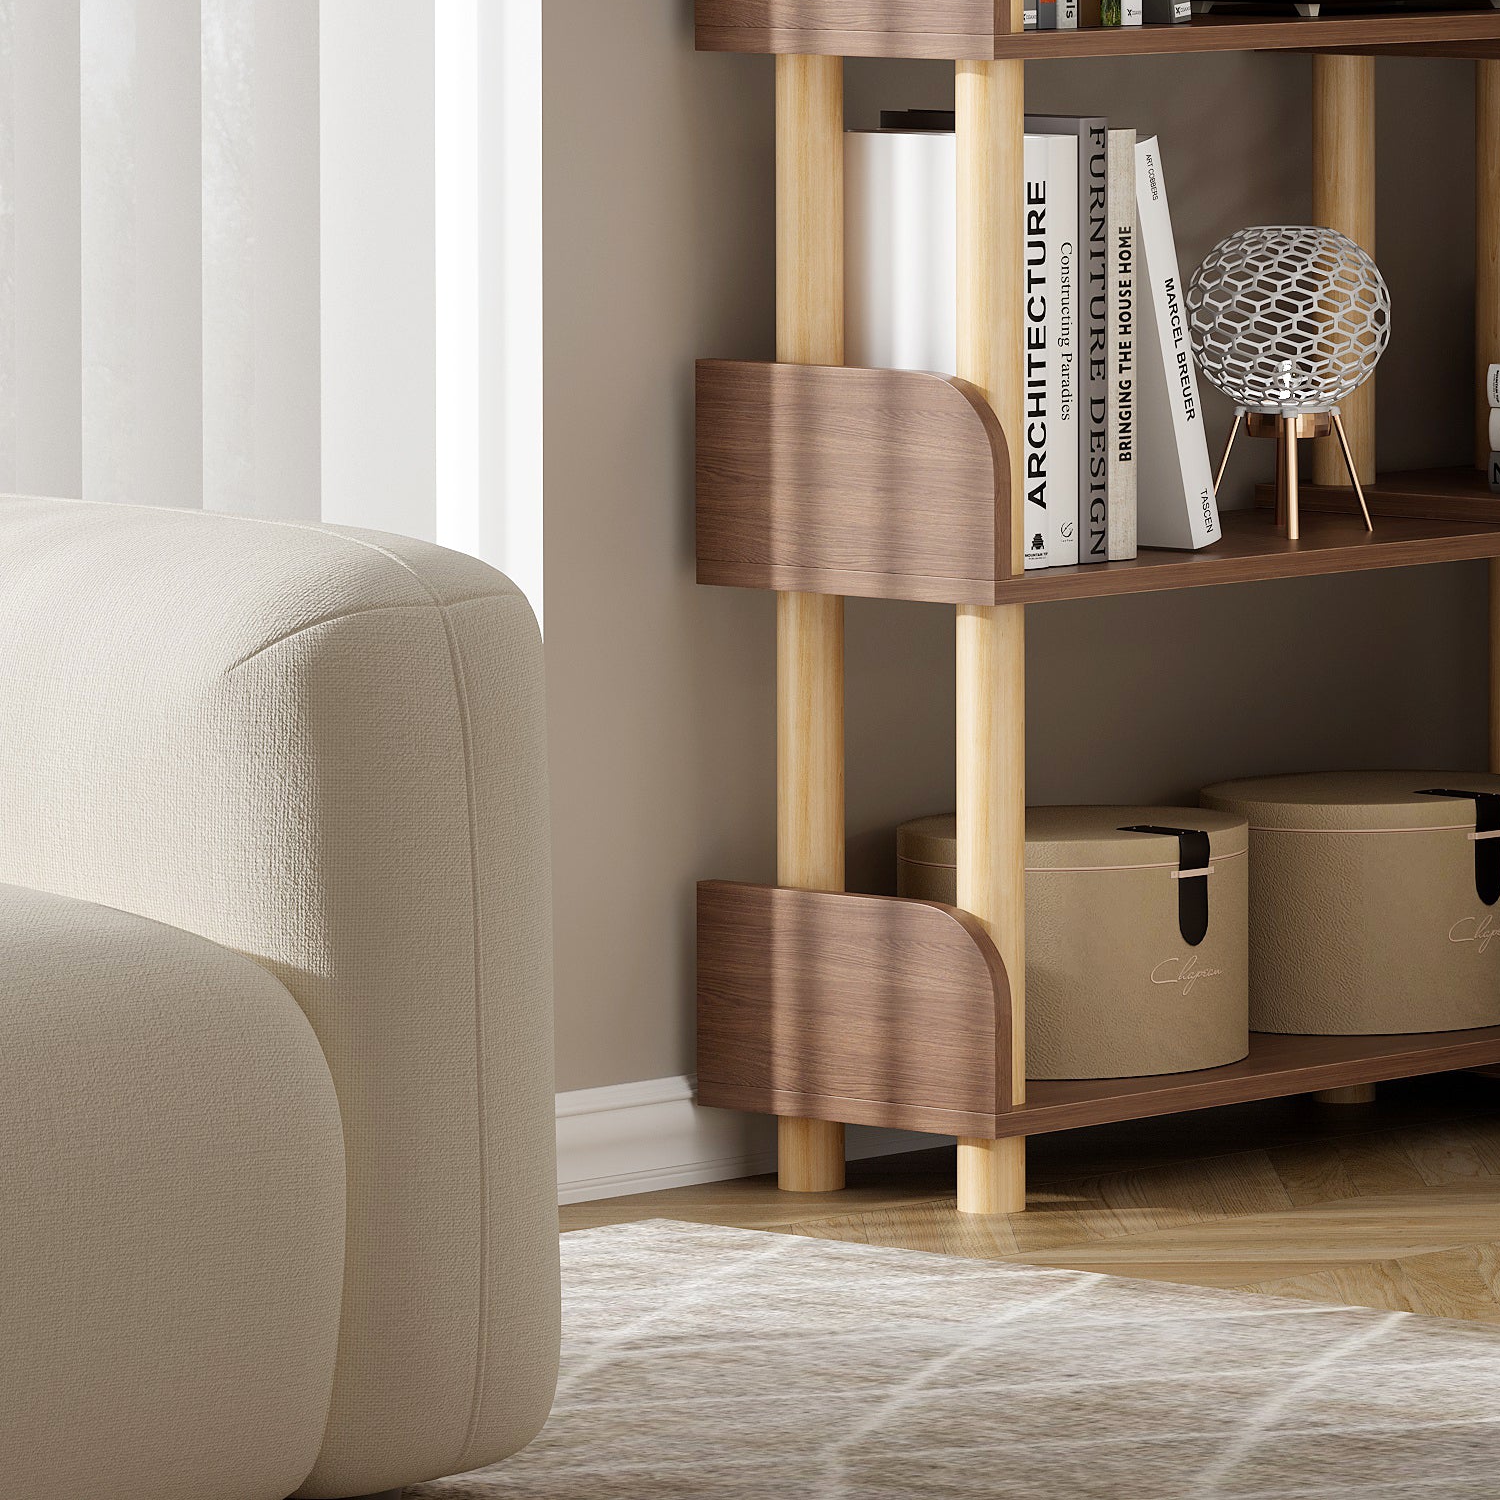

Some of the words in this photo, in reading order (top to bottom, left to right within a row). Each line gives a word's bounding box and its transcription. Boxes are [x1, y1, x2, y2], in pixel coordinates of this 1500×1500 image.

[1145, 153, 1154, 167] ART
[1148, 168, 1159, 201] COBBERS
[1090, 125, 1106, 381] FURNITURE
[1118, 226, 1132, 274] HOME
[1057, 241, 1073, 348] Constructing
[1118, 279, 1132, 335] HOUSE
[1027, 180, 1047, 510] ARCHITECTURE
[1118, 341, 1132, 374] THE
[1164, 277, 1184, 349] MARCEL
[1176, 351, 1196, 422] BREUER
[1061, 352, 1073, 421] Paradies
[1118, 379, 1132, 462] BRINGING
[1090, 395, 1106, 556] DESIGN
[1199, 487, 1214, 533] TASCEN
